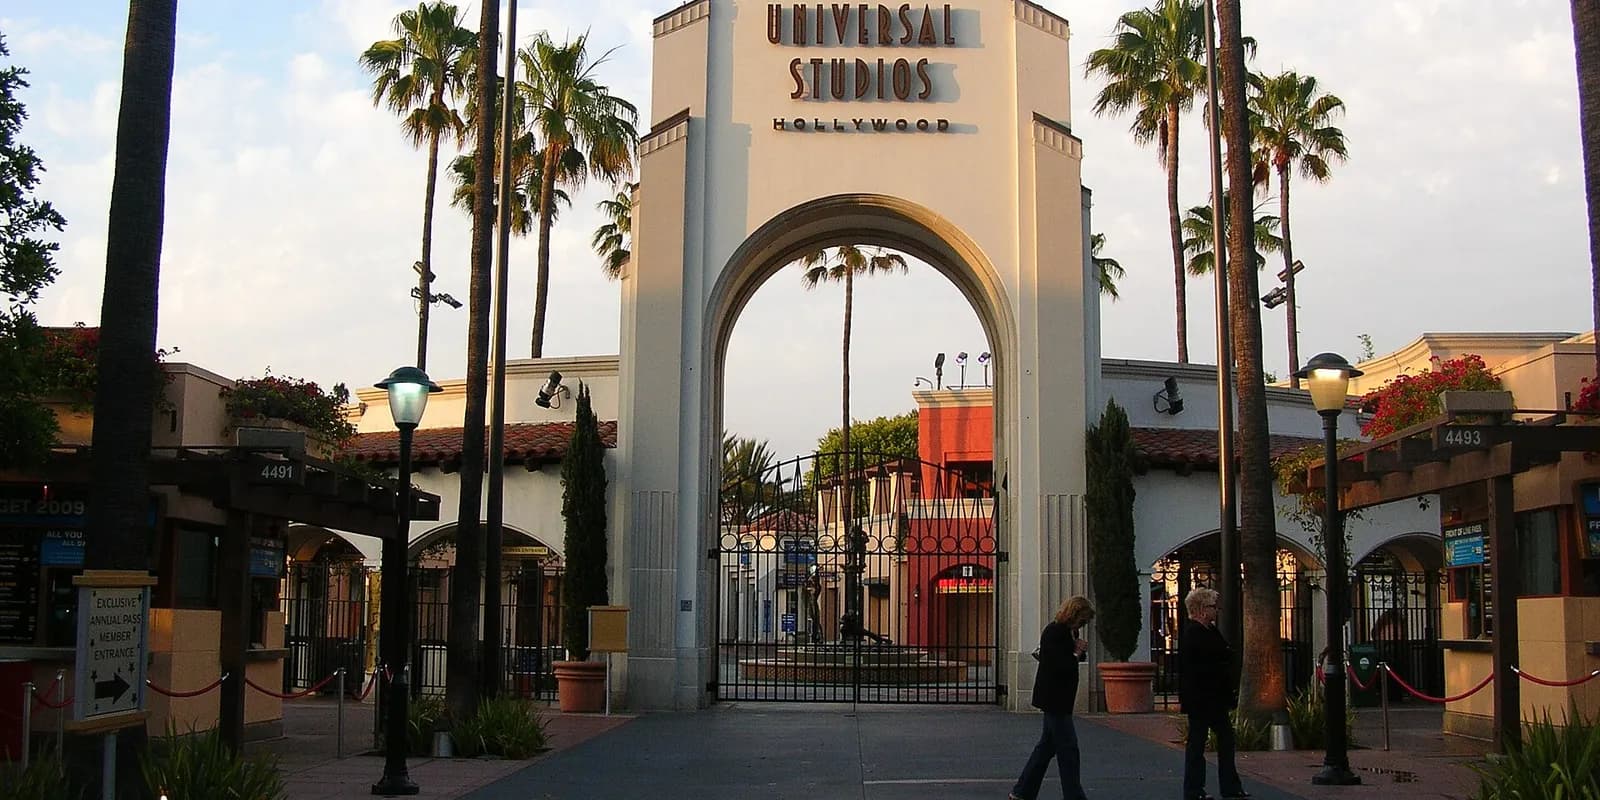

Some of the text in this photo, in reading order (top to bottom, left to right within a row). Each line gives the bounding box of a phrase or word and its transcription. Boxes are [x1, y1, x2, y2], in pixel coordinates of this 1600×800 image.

[767, 3, 955, 45] UNIVERSAL
[789, 57, 932, 100] STUDIOS
[773, 117, 949, 132] HOLLYWOOD
[1445, 430, 1480, 445] 4493
[261, 465, 292, 479] 4491
[38, 500, 85, 515] 2009
[64, 531, 83, 539] YOU
[97, 597, 137, 609] EXCLUSIVE
[90, 614, 141, 627] ANNUAL PASS
[100, 631, 131, 642] MEMBER
[94, 647, 135, 661] ENTRANCE
